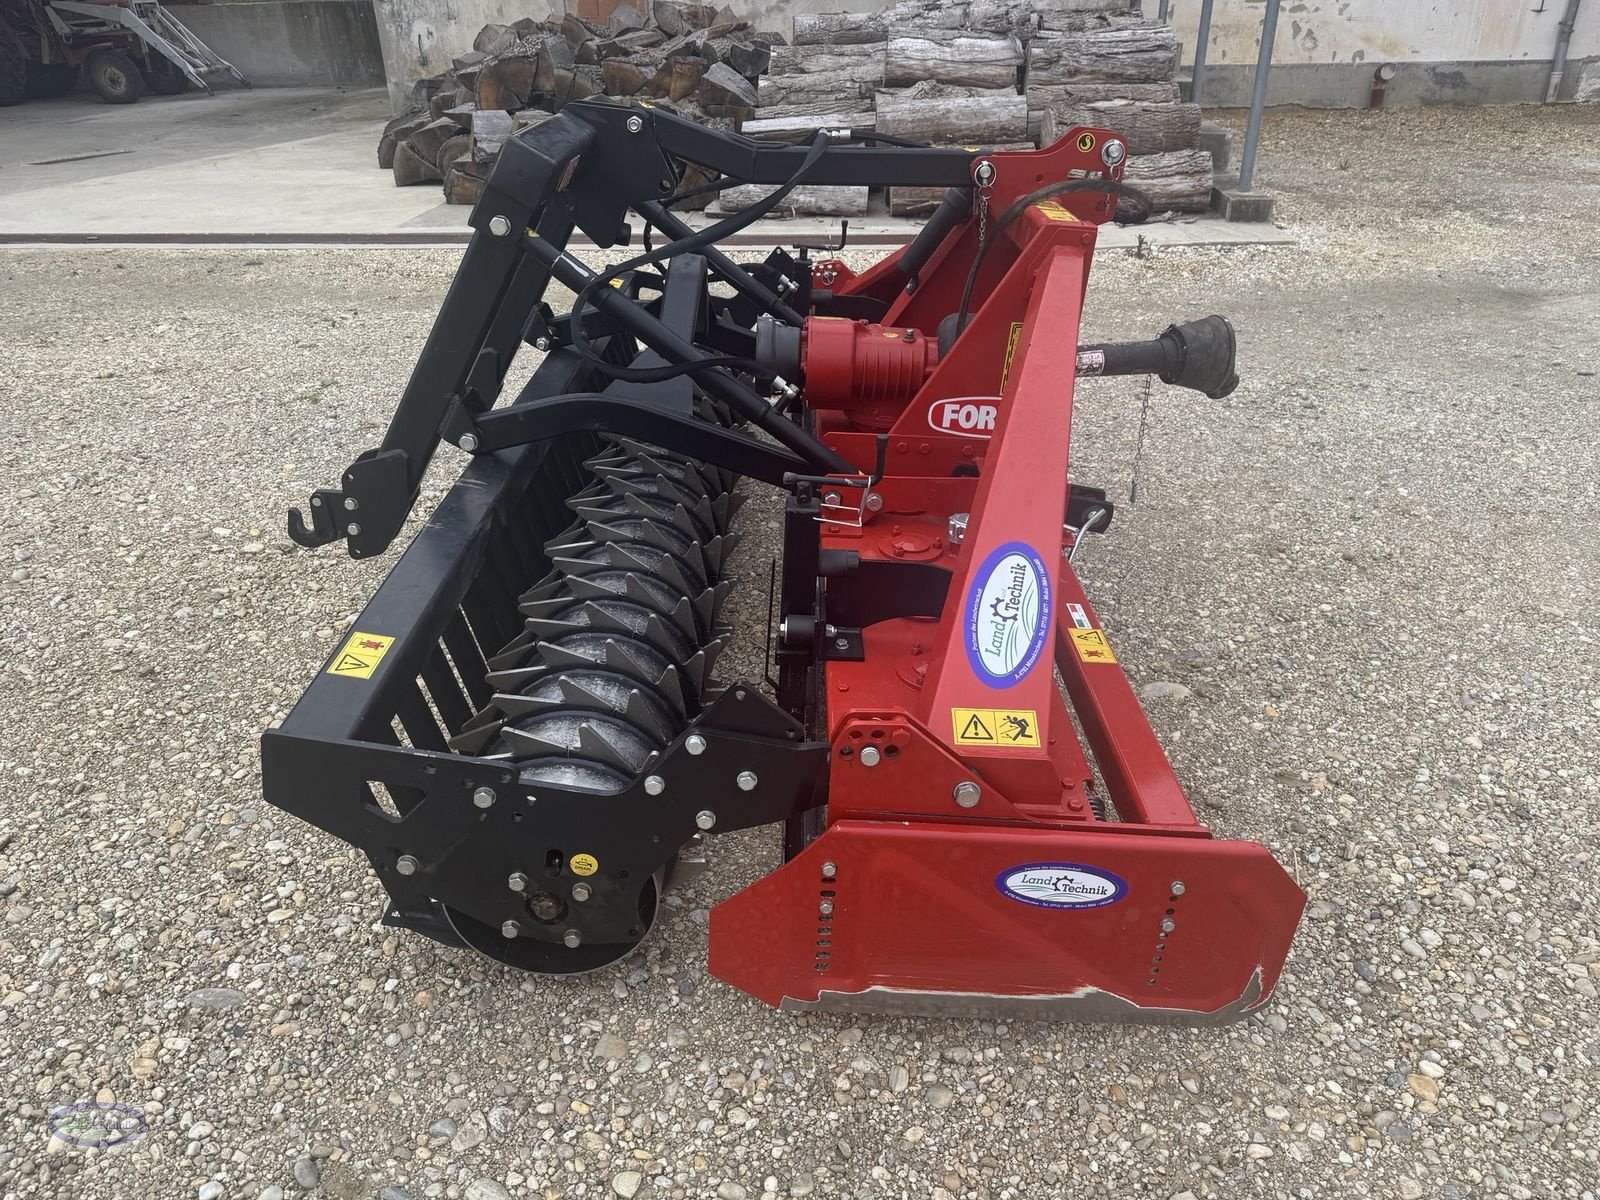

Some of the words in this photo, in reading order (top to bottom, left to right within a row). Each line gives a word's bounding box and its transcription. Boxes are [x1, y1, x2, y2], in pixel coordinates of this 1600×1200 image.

[985, 620, 1006, 657] Land
[1005, 564, 1026, 611] Technik
[1021, 875, 1052, 885] Land
[1062, 884, 1107, 895] Technik
